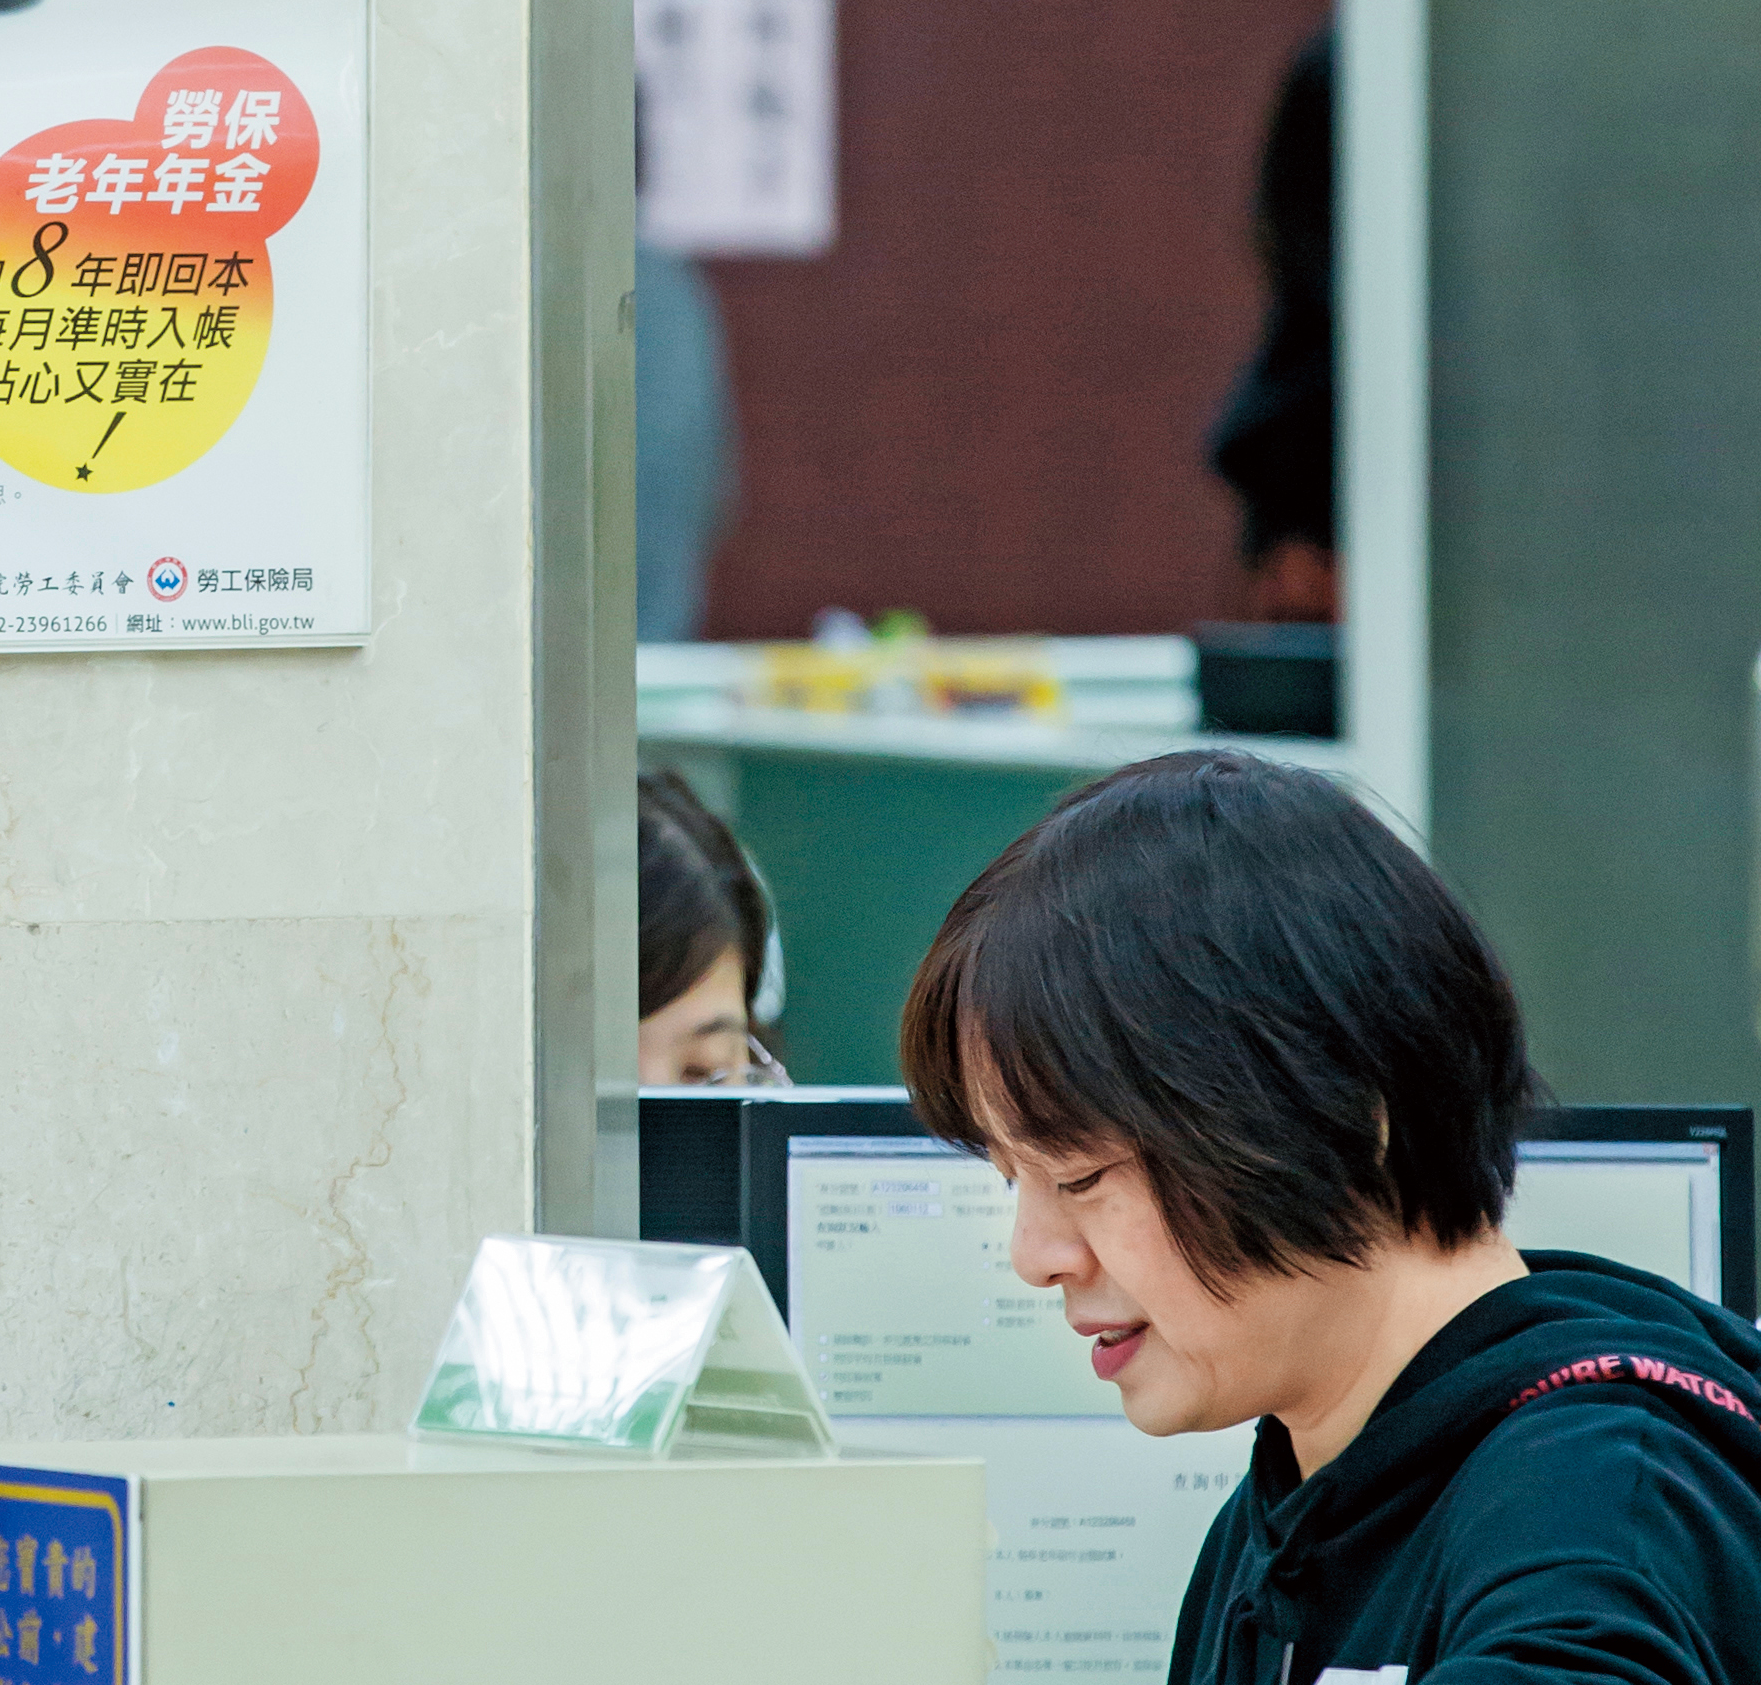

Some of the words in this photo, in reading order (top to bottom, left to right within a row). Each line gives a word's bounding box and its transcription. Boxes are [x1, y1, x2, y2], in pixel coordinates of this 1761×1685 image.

[161, 88, 282, 150] 勞保
[25, 152, 271, 215] 老年年金
[197, 567, 314, 593] 勞工保險局
